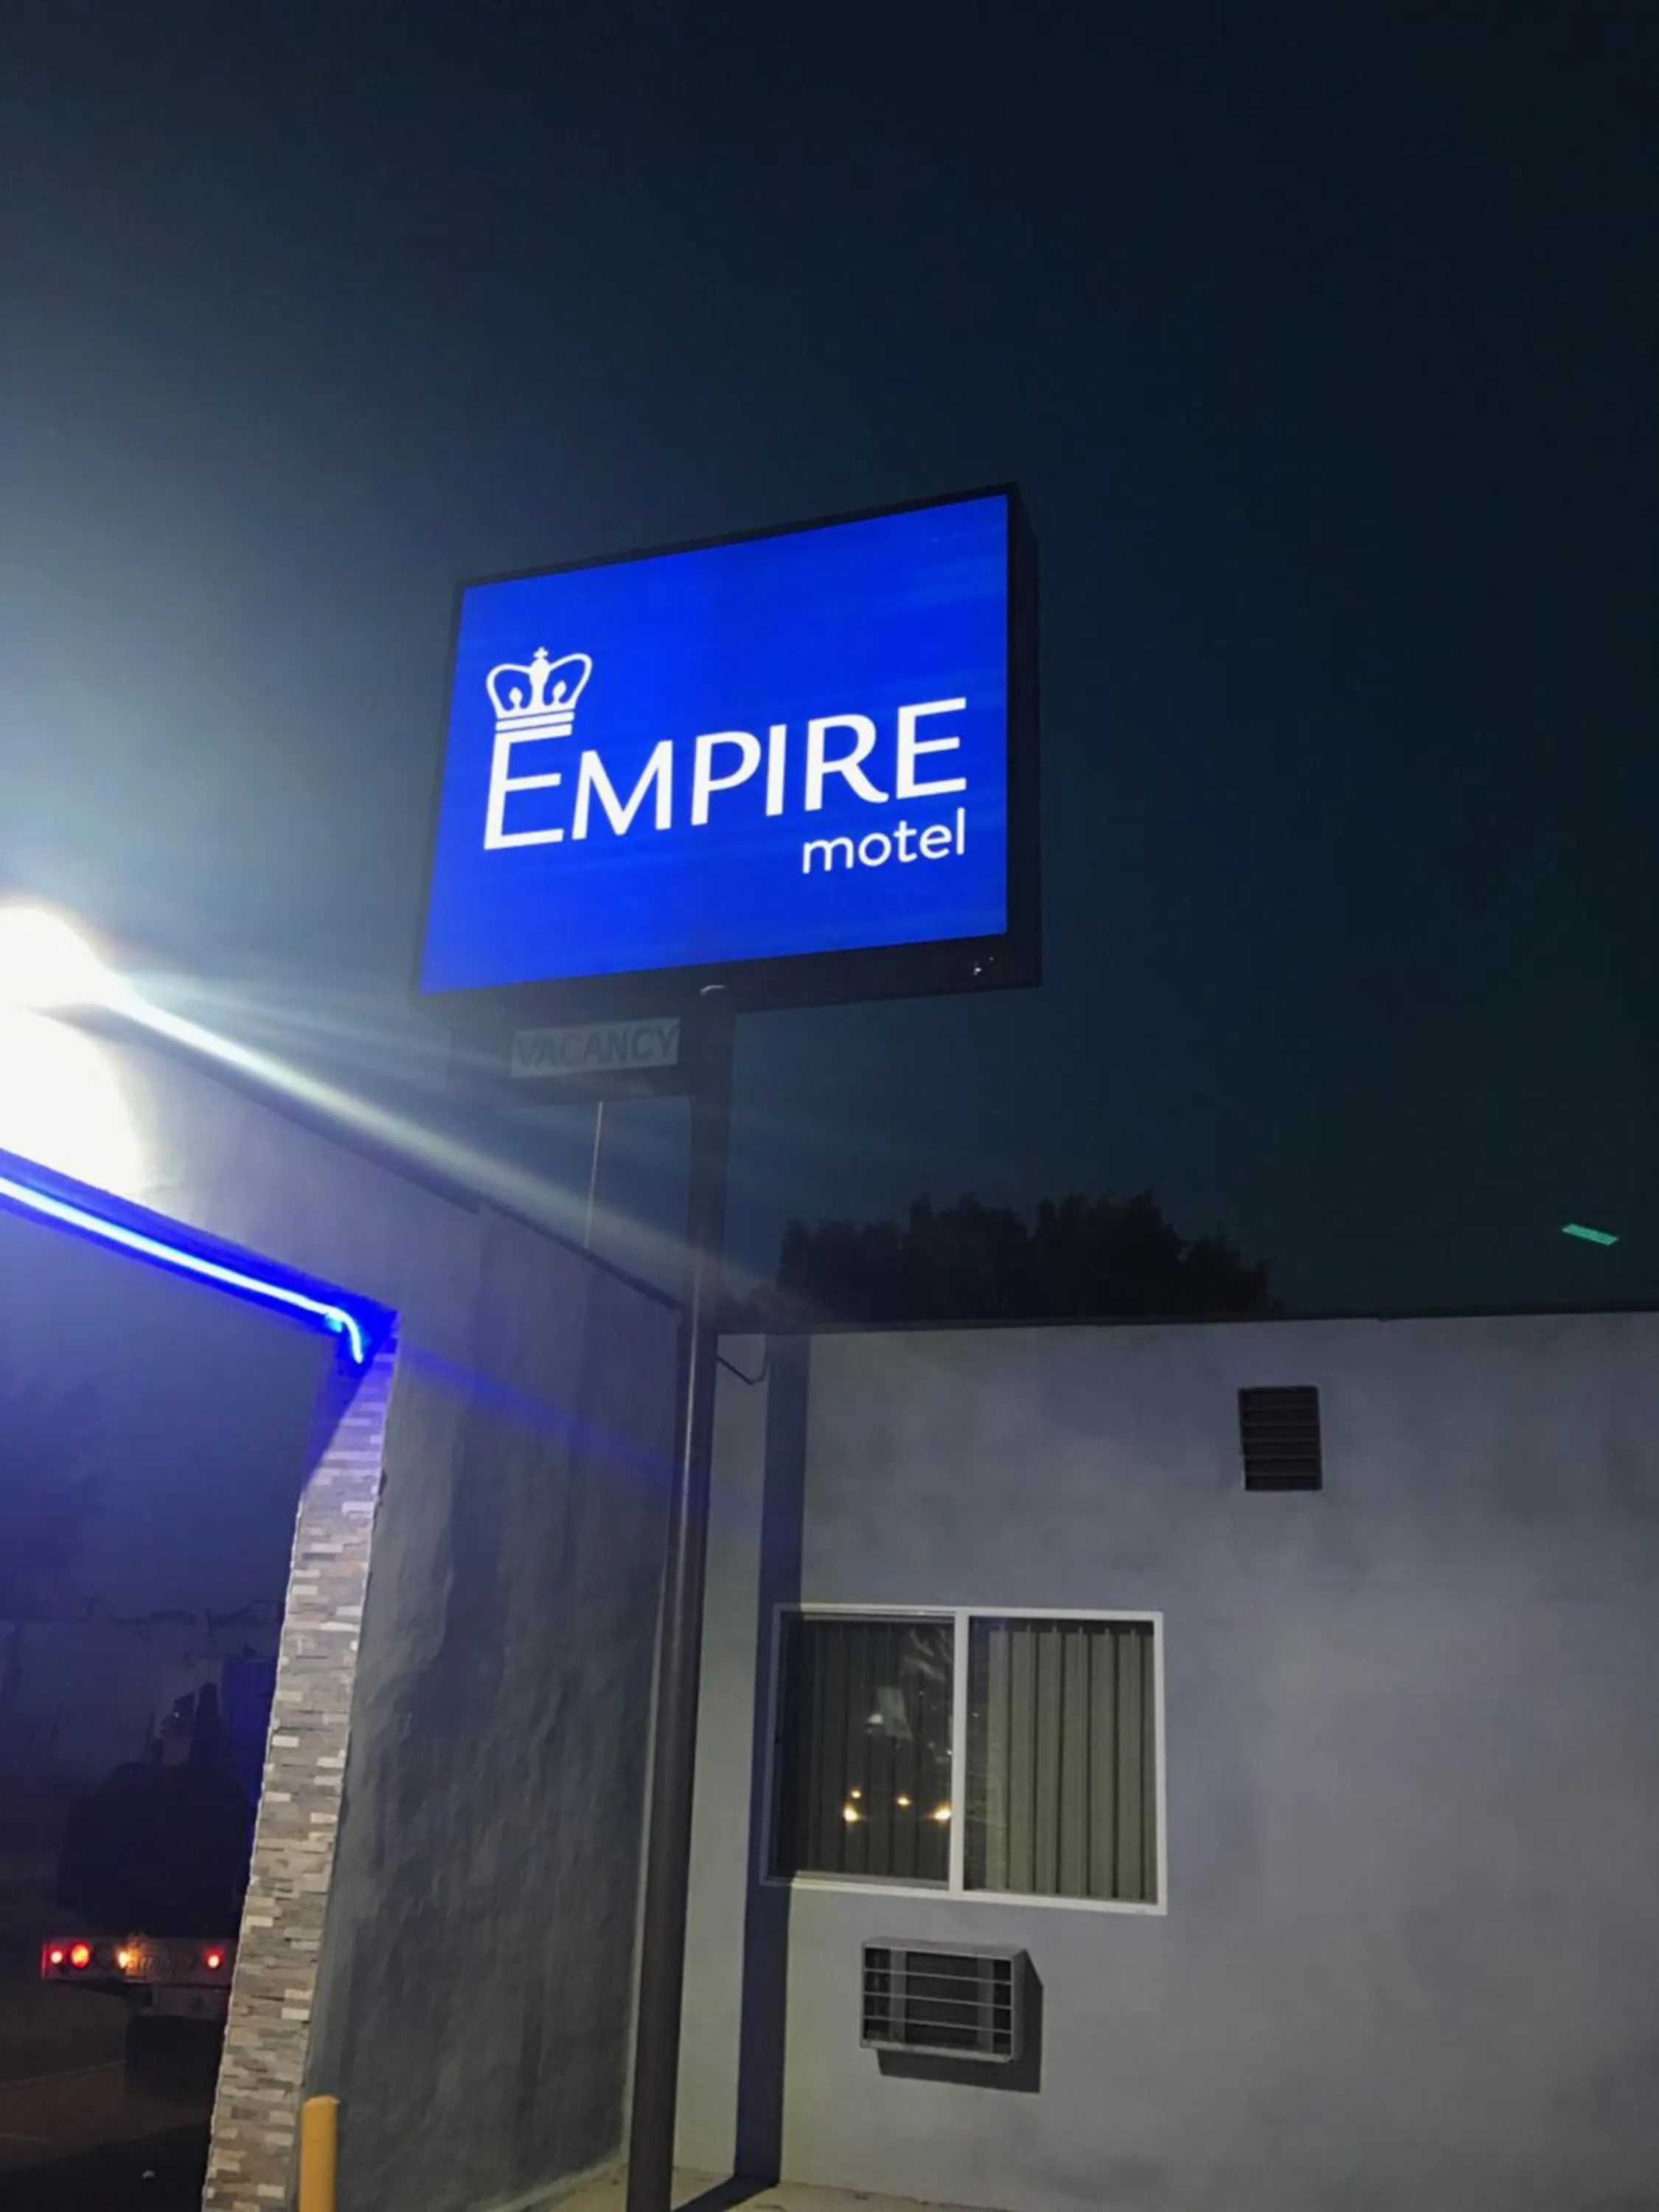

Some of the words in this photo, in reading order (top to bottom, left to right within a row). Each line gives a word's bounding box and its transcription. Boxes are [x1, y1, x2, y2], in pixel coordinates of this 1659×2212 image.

[484, 697, 967, 850] EMPIRE
[802, 807, 965, 874] motel
[516, 1023, 680, 1068] VACANCY
